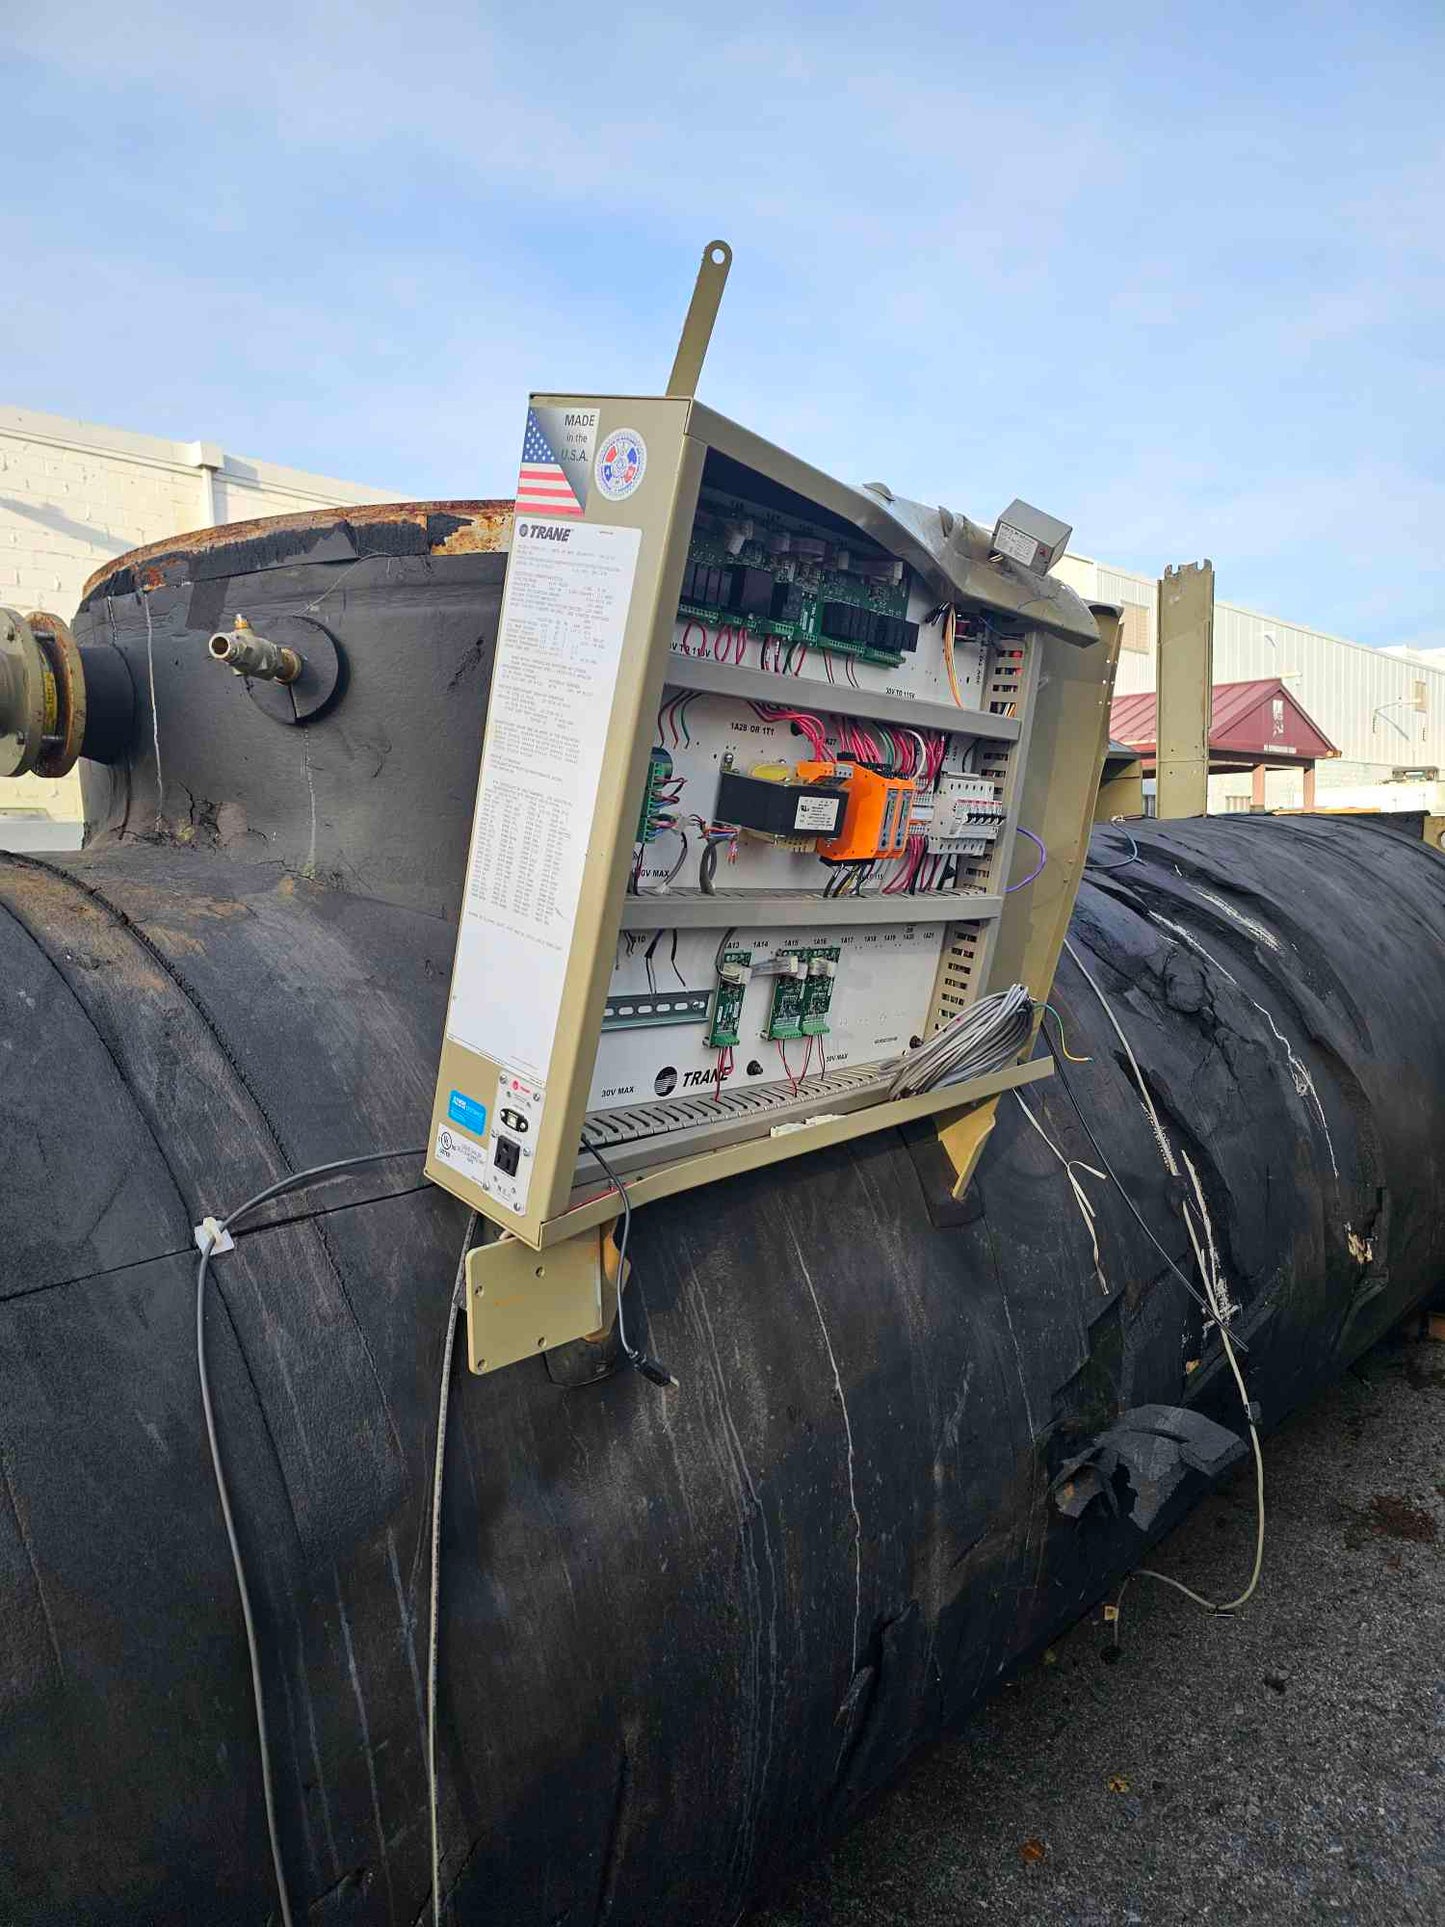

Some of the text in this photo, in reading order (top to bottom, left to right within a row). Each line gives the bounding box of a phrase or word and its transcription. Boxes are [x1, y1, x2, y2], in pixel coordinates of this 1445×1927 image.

[564, 414, 595, 427] MADE
[566, 433, 588, 443] in the
[561, 449, 589, 462] U.S.A.
[529, 525, 570, 542] TRANE
[652, 869, 670, 878] MAX
[682, 1066, 729, 1088] TRANE
[601, 1086, 634, 1098] 30V MAX
